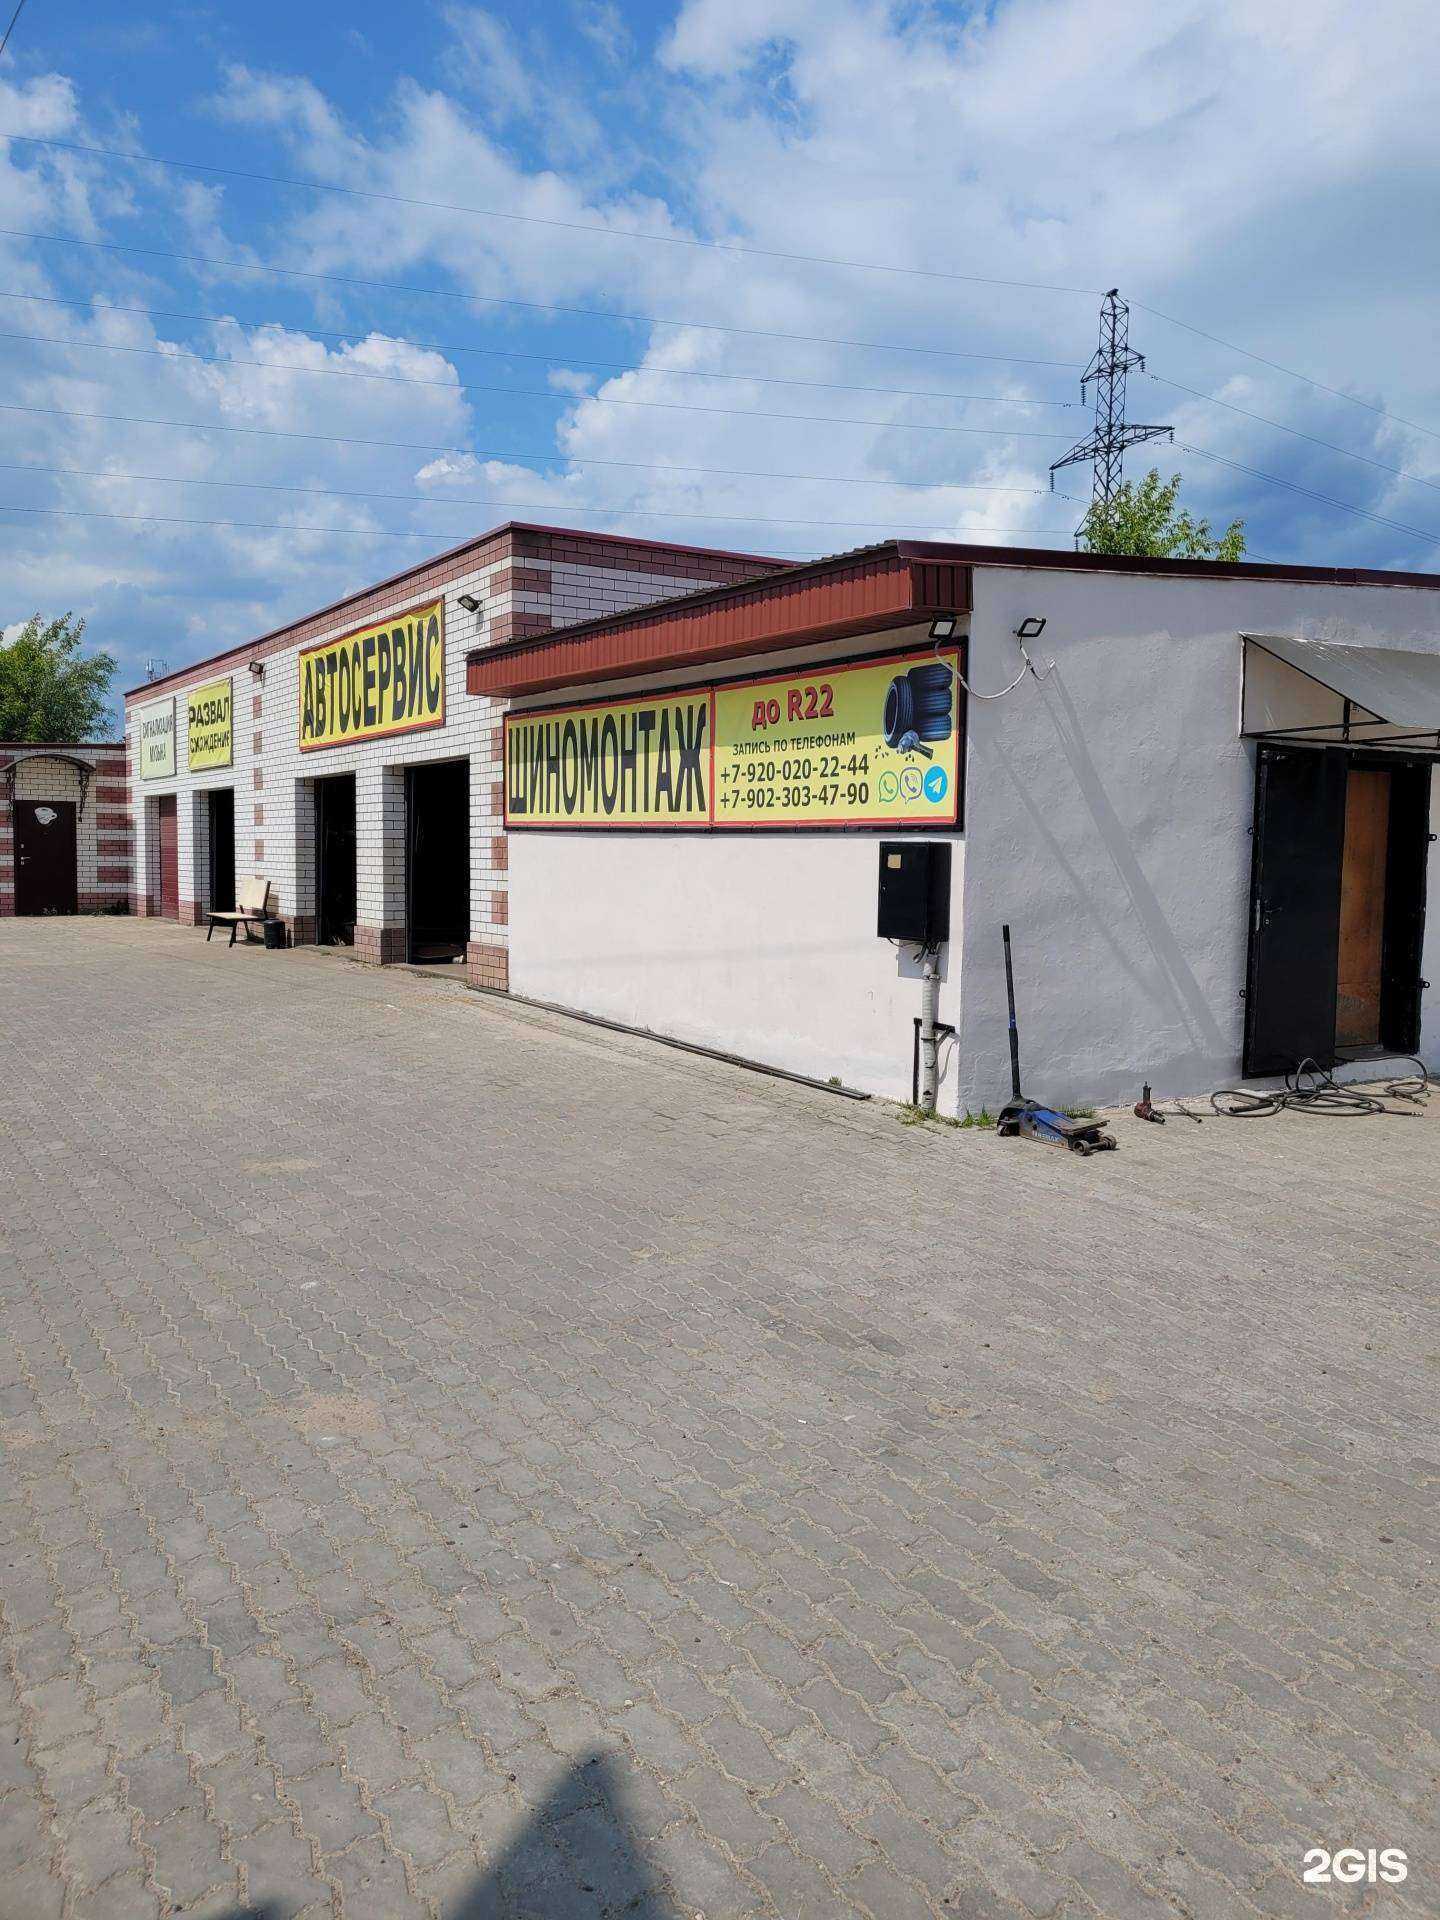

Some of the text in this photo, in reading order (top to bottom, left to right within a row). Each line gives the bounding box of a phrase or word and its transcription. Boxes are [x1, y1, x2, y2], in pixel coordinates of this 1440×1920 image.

[302, 614, 440, 739] АВТОСЕРВИС
[188, 696, 230, 730] РАЗВАЛ
[787, 684, 834, 721] R22
[190, 730, 230, 754] СХОЖДЕНИЕ
[733, 731, 856, 756] ЗАПИСЬ ПО ТЕЛЕФОНАМ
[508, 702, 707, 815] ШИНОМОНТАЖ
[721, 753, 869, 783] +7-920-020-22-44
[720, 782, 869, 808] +7-902-303-47-90
